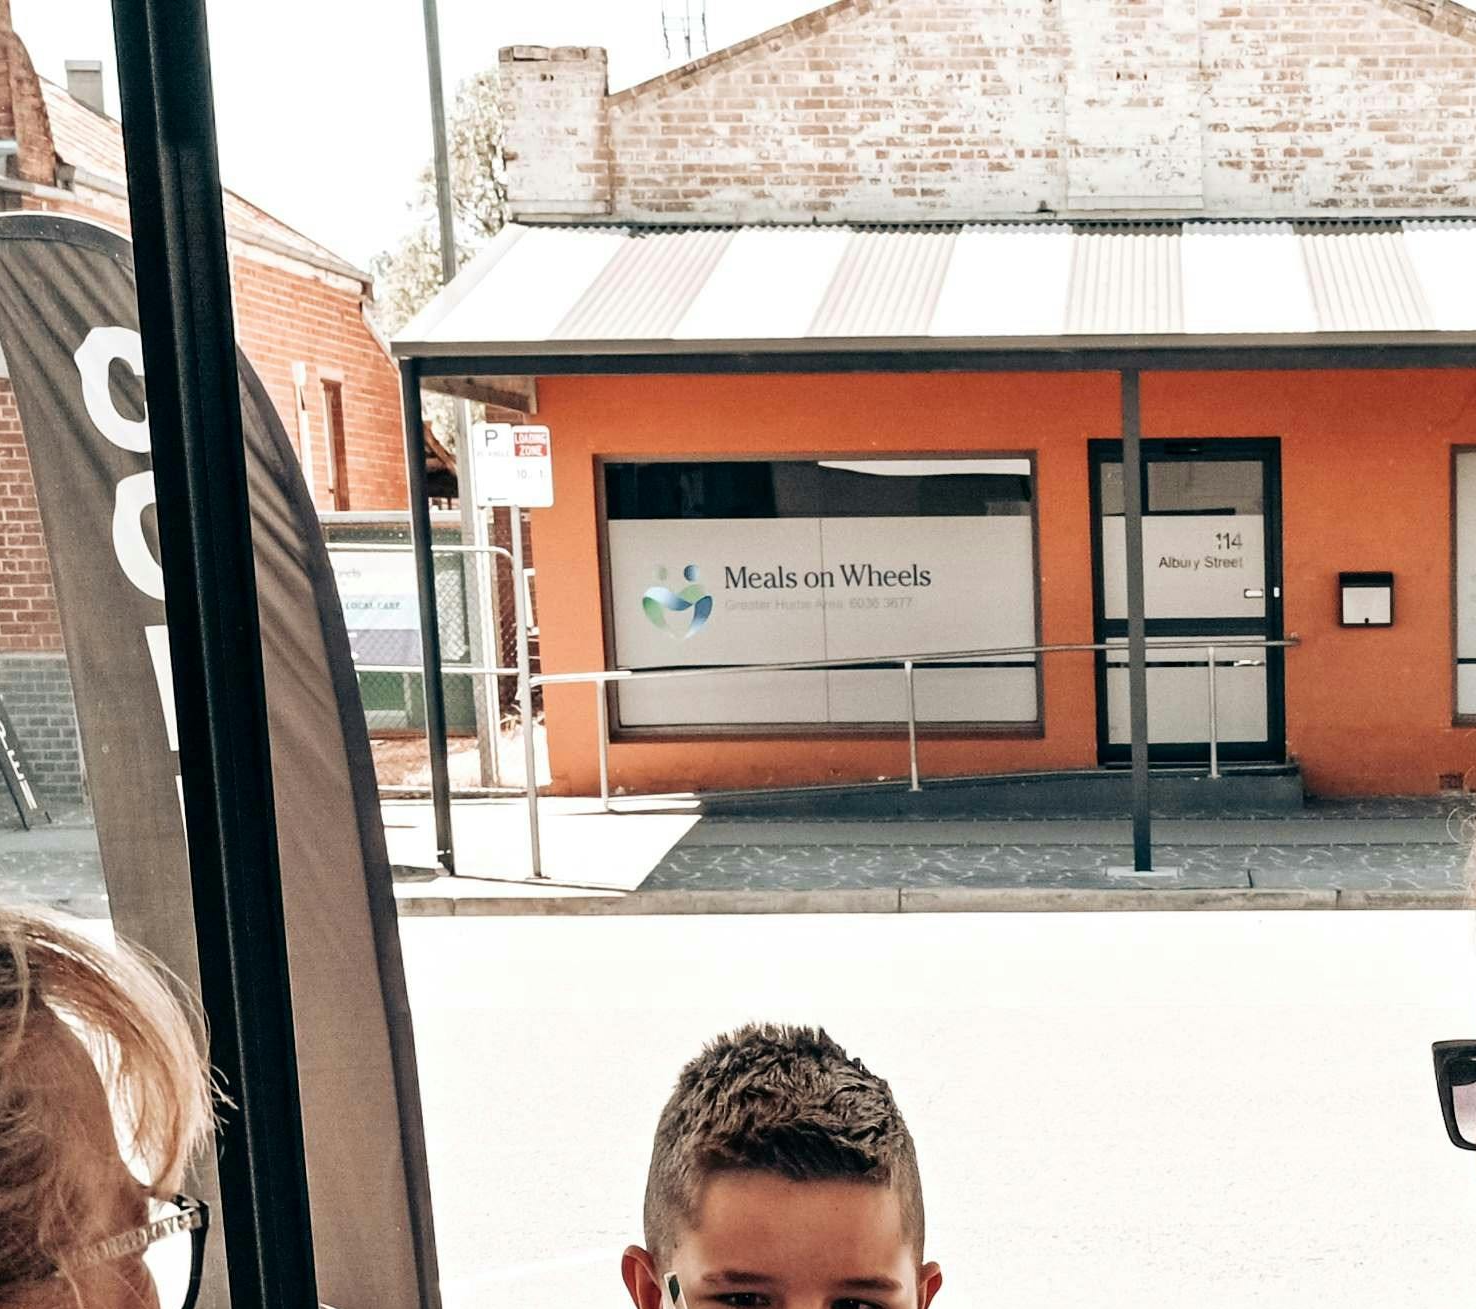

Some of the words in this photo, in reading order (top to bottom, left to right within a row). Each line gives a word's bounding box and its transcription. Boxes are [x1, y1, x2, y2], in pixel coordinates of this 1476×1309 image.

[485, 429, 498, 447] P
[1158, 556, 1200, 571] Albury
[1204, 556, 1243, 569] Street
[725, 565, 797, 589] Meals
[804, 570, 835, 588] on
[840, 564, 932, 587] Wheels
